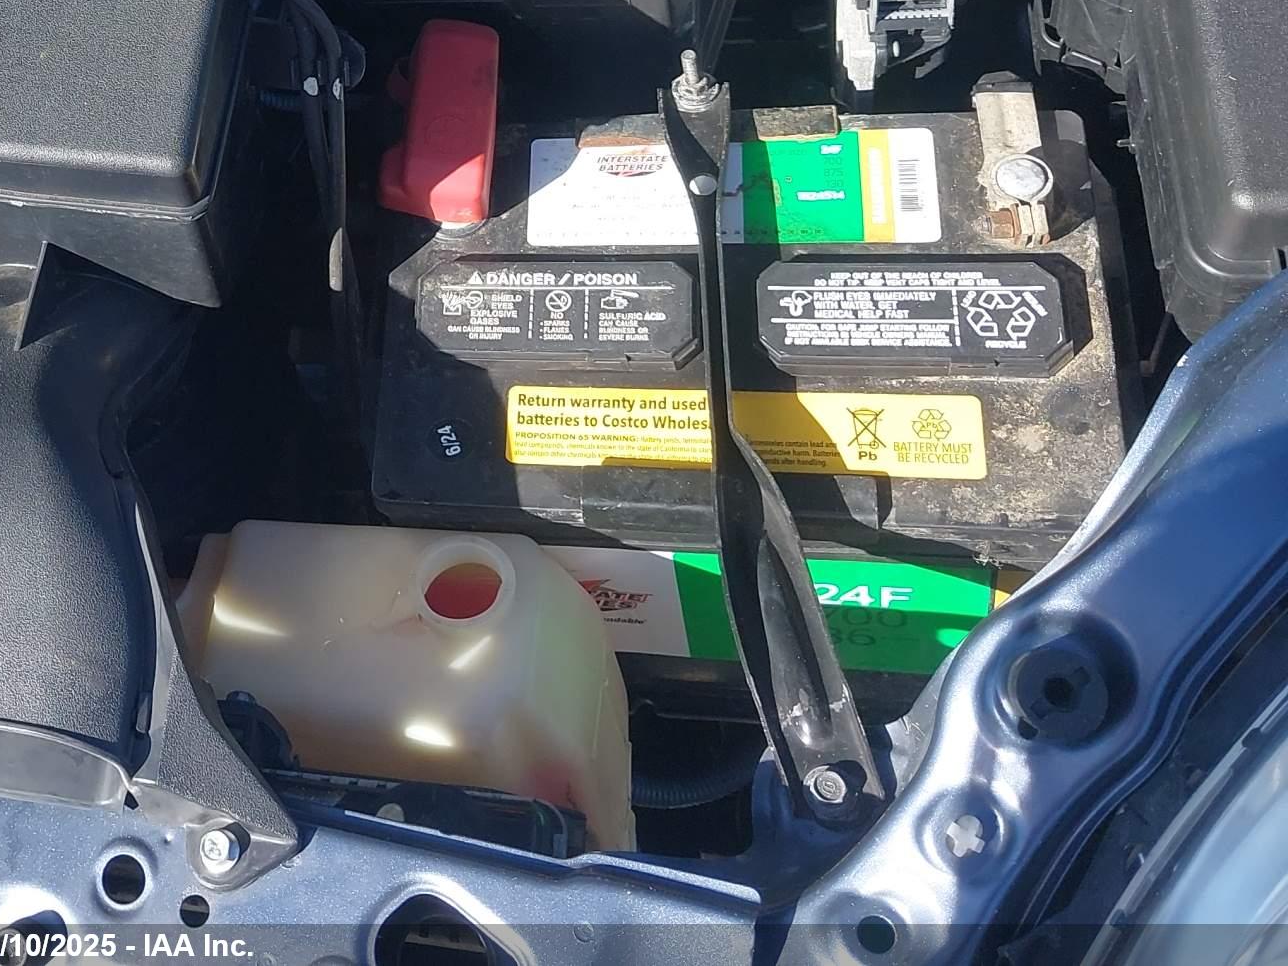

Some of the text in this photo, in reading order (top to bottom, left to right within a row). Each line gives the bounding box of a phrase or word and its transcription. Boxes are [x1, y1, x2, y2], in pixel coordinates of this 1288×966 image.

[597, 155, 669, 164] INTERSTATE
[599, 163, 663, 172] BATTERIES
[486, 272, 556, 285] DANGER
[574, 273, 638, 285] POISON
[491, 294, 522, 302] SHIELD
[814, 292, 936, 301] FLUSH EYES IMMEDIATELY
[814, 301, 839, 310] WITH
[878, 301, 898, 310] GET
[470, 309, 518, 318] EXPLOSIVE
[644, 312, 666, 320] ACID
[815, 310, 909, 319] MEDICAL HELP FAST
[470, 317, 500, 325] GASES
[518, 394, 706, 412] Return warranty and used
[517, 412, 579, 426] batteries
[584, 414, 598, 427] to
[602, 415, 648, 428] Costco
[437, 425, 461, 456] 6/24
[515, 432, 575, 440] PROPOSITION
[592, 434, 639, 442] WARNING:
[894, 441, 972, 454] BATTERY MUST
[859, 451, 877, 461] Pb
[898, 453, 969, 464] BE RECYCLED
[814, 583, 914, 611] 24F
